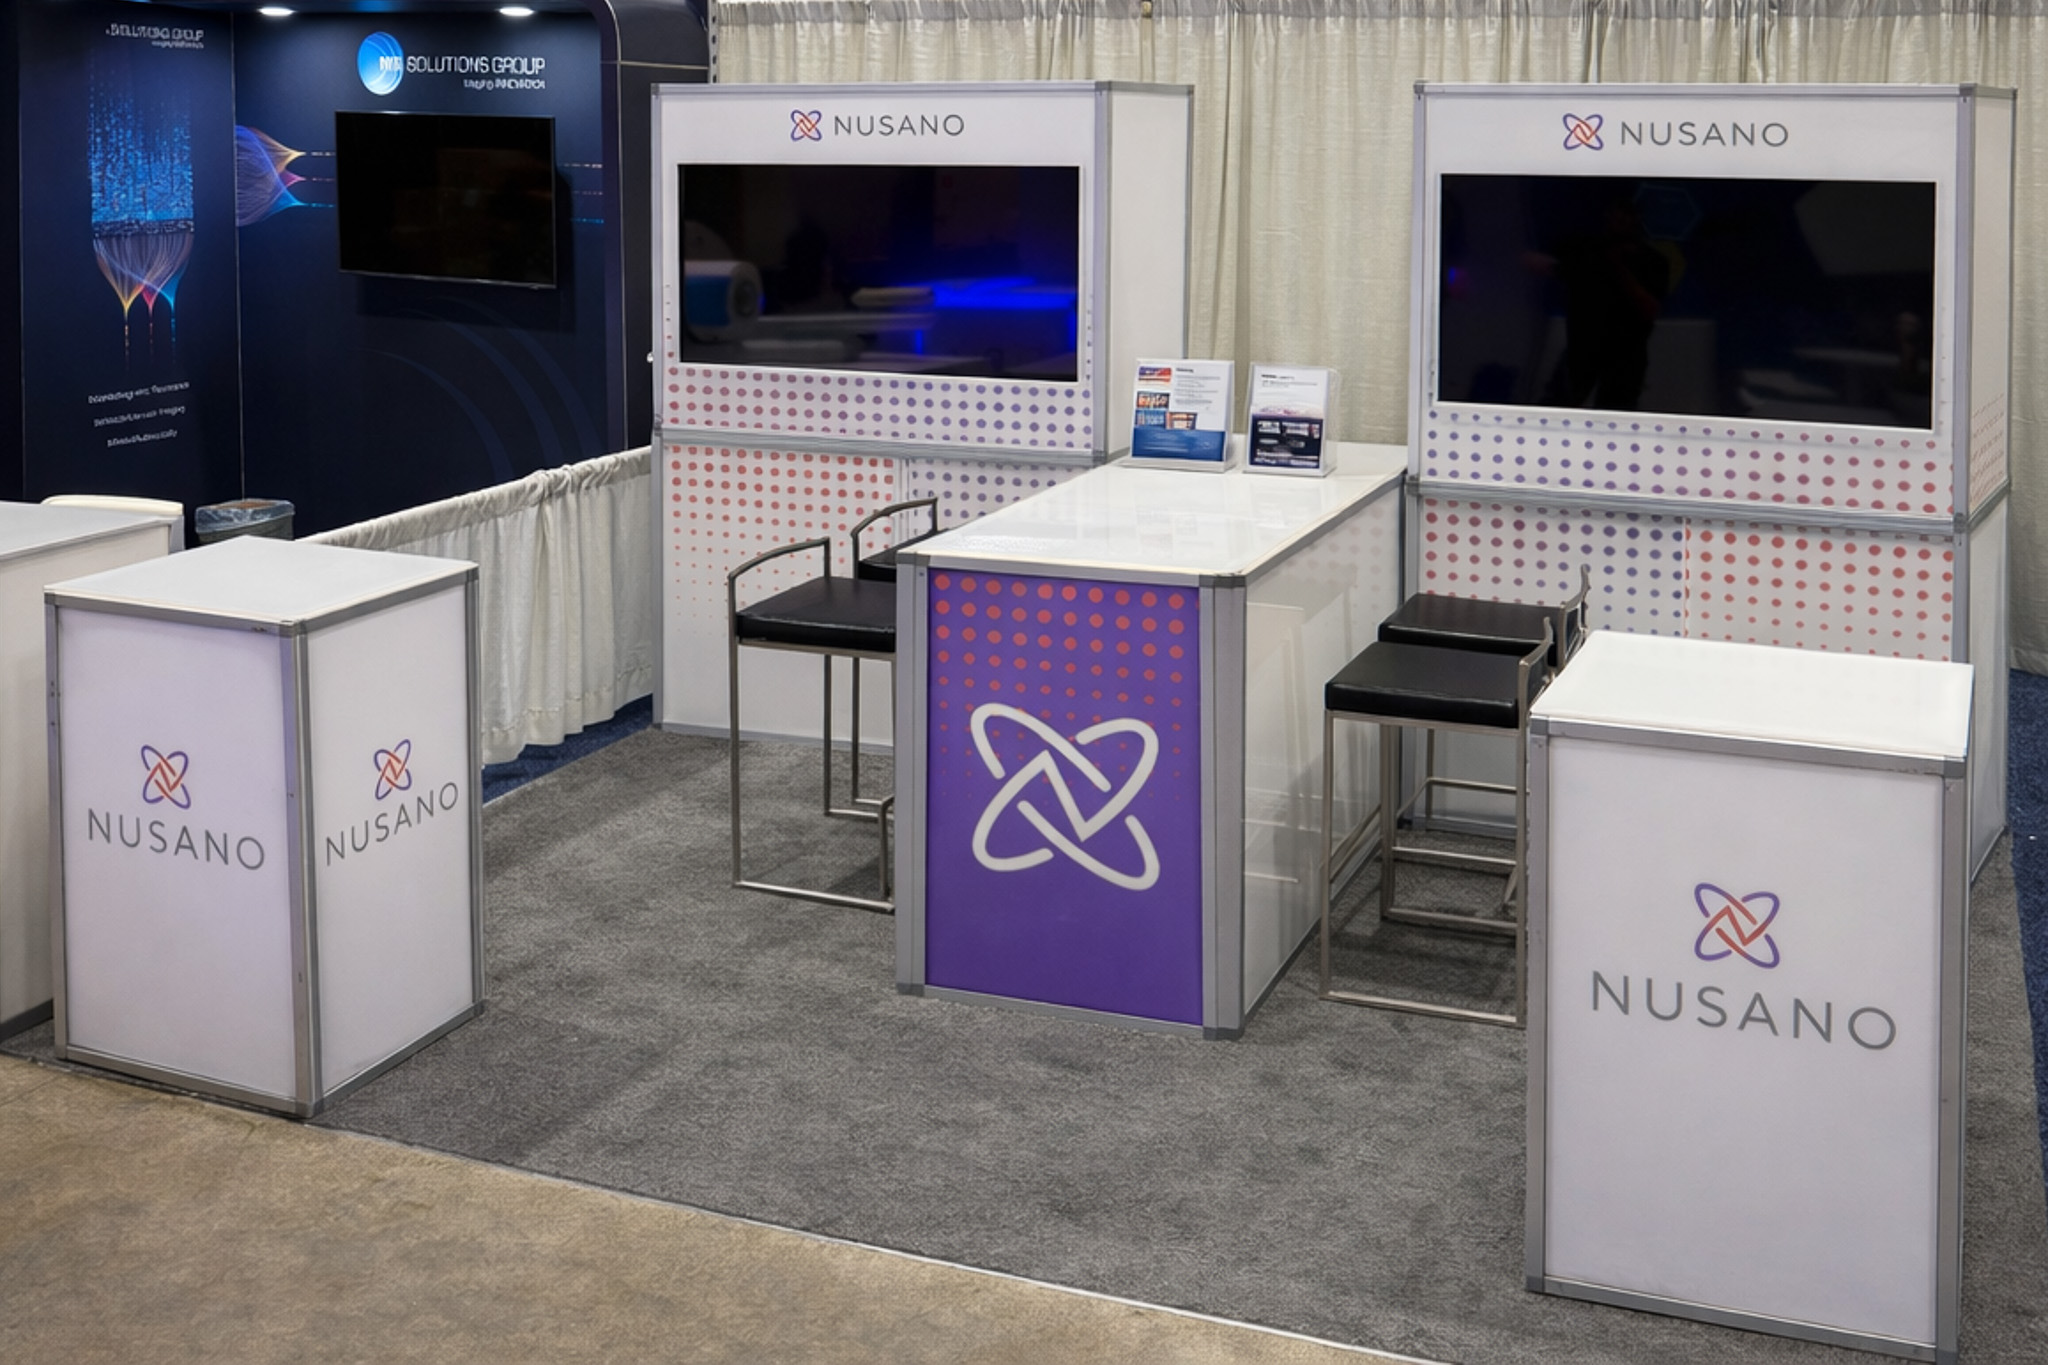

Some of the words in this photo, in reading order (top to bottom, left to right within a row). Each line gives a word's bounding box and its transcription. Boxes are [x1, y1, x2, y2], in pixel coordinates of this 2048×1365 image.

[406, 56, 490, 73] SOLUTIONS
[491, 57, 546, 75] GROUP
[834, 114, 965, 137] NUSANO
[1621, 121, 1789, 147] NUSANO
[88, 808, 265, 870] NUSANO
[326, 782, 459, 866] NUSANO
[1592, 970, 1896, 1050] NUSANO
